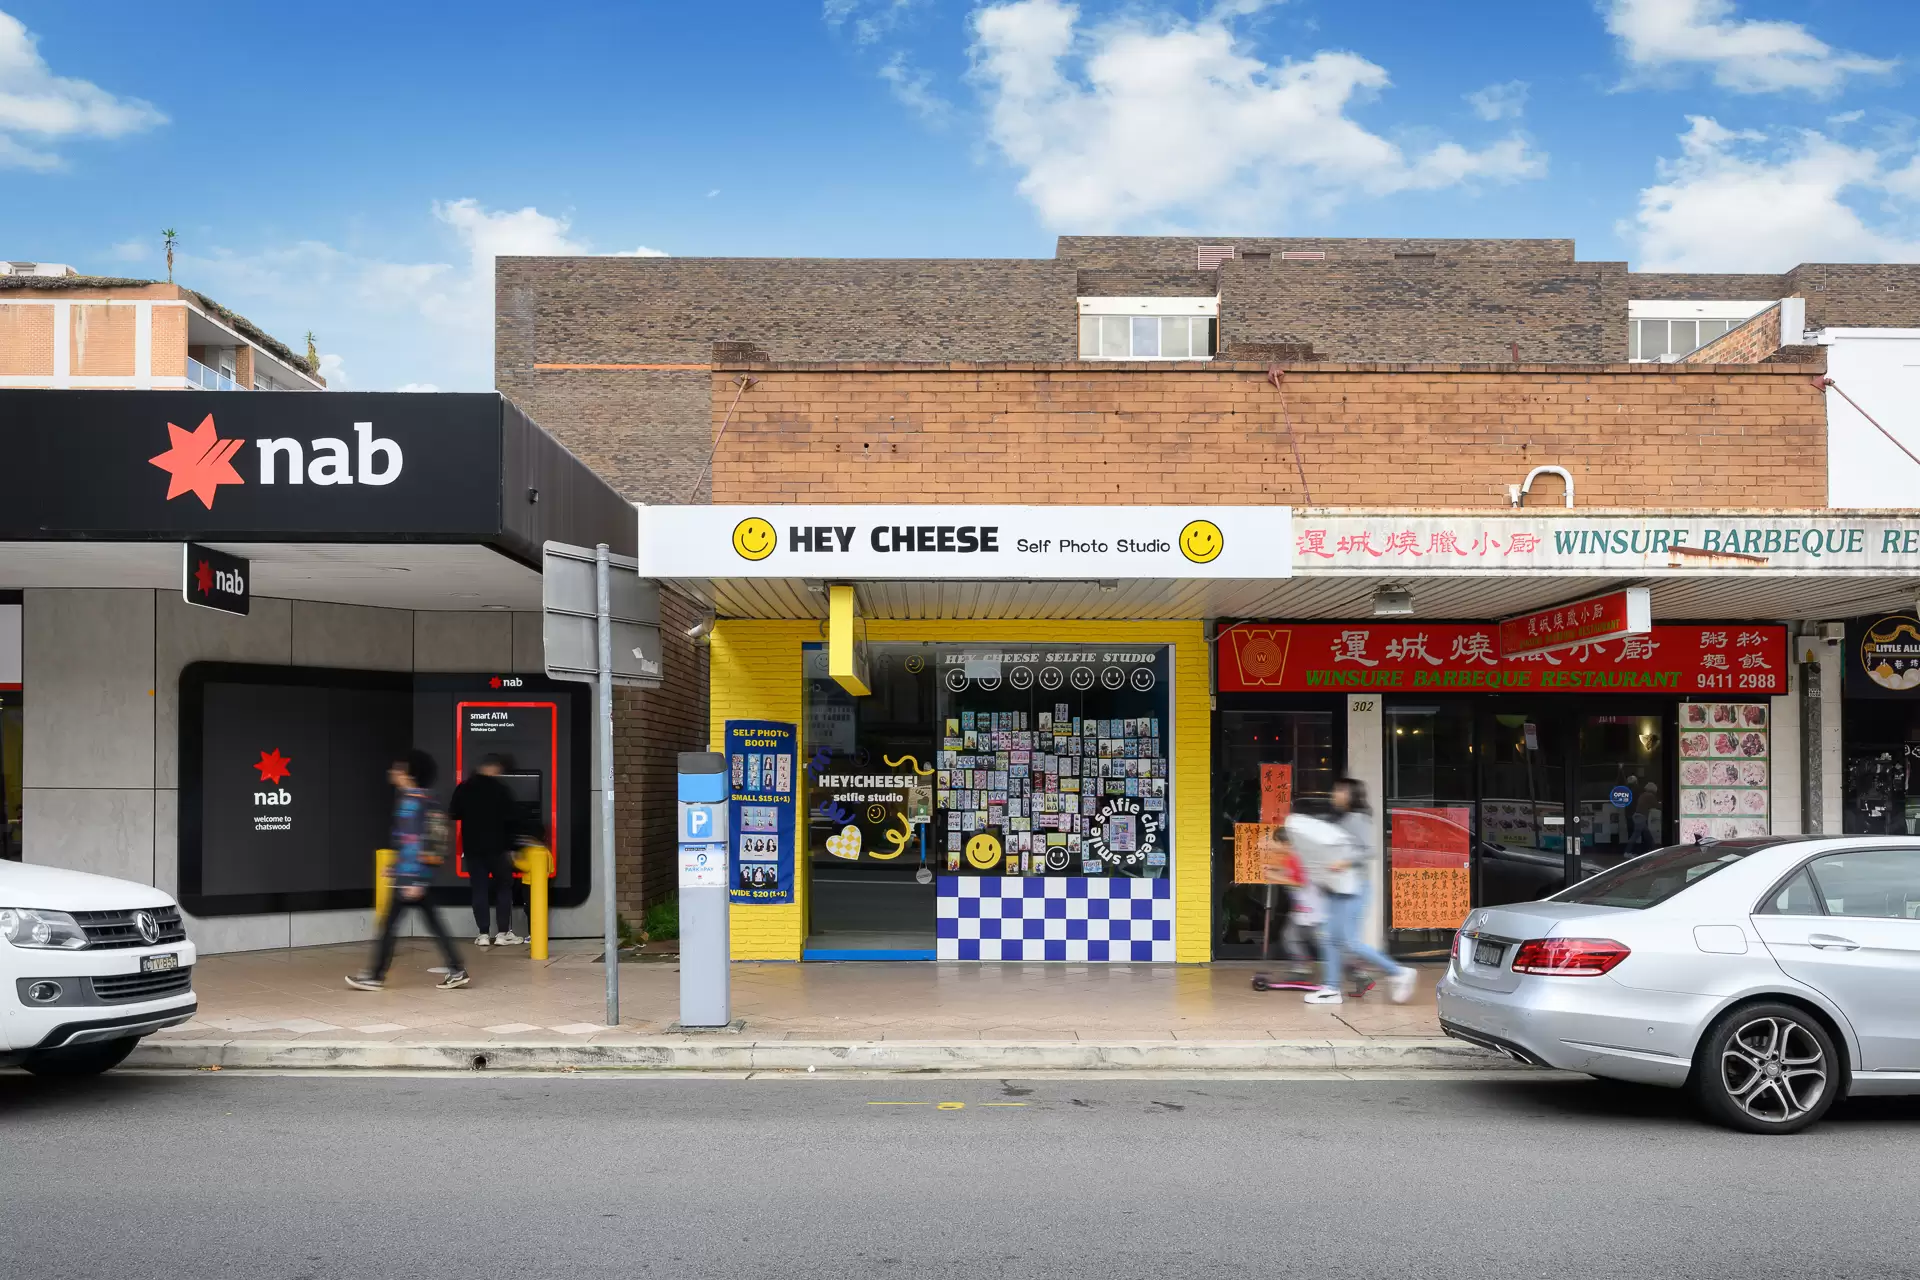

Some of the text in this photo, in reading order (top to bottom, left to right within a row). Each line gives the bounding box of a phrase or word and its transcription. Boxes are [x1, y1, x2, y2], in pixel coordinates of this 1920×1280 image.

[256, 421, 404, 487] nab
[789, 525, 999, 553] HEY CHEESE
[1016, 537, 1171, 553] Self Photo Studio
[1553, 529, 1690, 555] WINSURE
[1703, 528, 1865, 558] BARBEQUE
[215, 568, 244, 596] nab
[1875, 644, 1920, 653] LITTLE ALL
[944, 652, 1156, 664] HEY CHEESE SELFIE STUDIO
[503, 677, 523, 687] nab
[1305, 669, 1683, 690] WINSURE BARBEQUE RESTAURANT
[1697, 674, 1776, 688] 9411 2988
[1352, 701, 1374, 712] 302
[470, 712, 508, 720] smart ATM
[744, 739, 777, 747] BOOTH
[818, 774, 918, 788] HEY!CHEESE!
[253, 788, 292, 806] nab
[731, 794, 757, 802] SMALL
[773, 795, 791, 803] (1+1)
[833, 792, 904, 802] selfie studio
[253, 815, 284, 823] welcome
[692, 811, 709, 834] P
[1087, 797, 1159, 865] selfie cheese smile
[730, 889, 787, 898] WIDE $20 (1+1)
